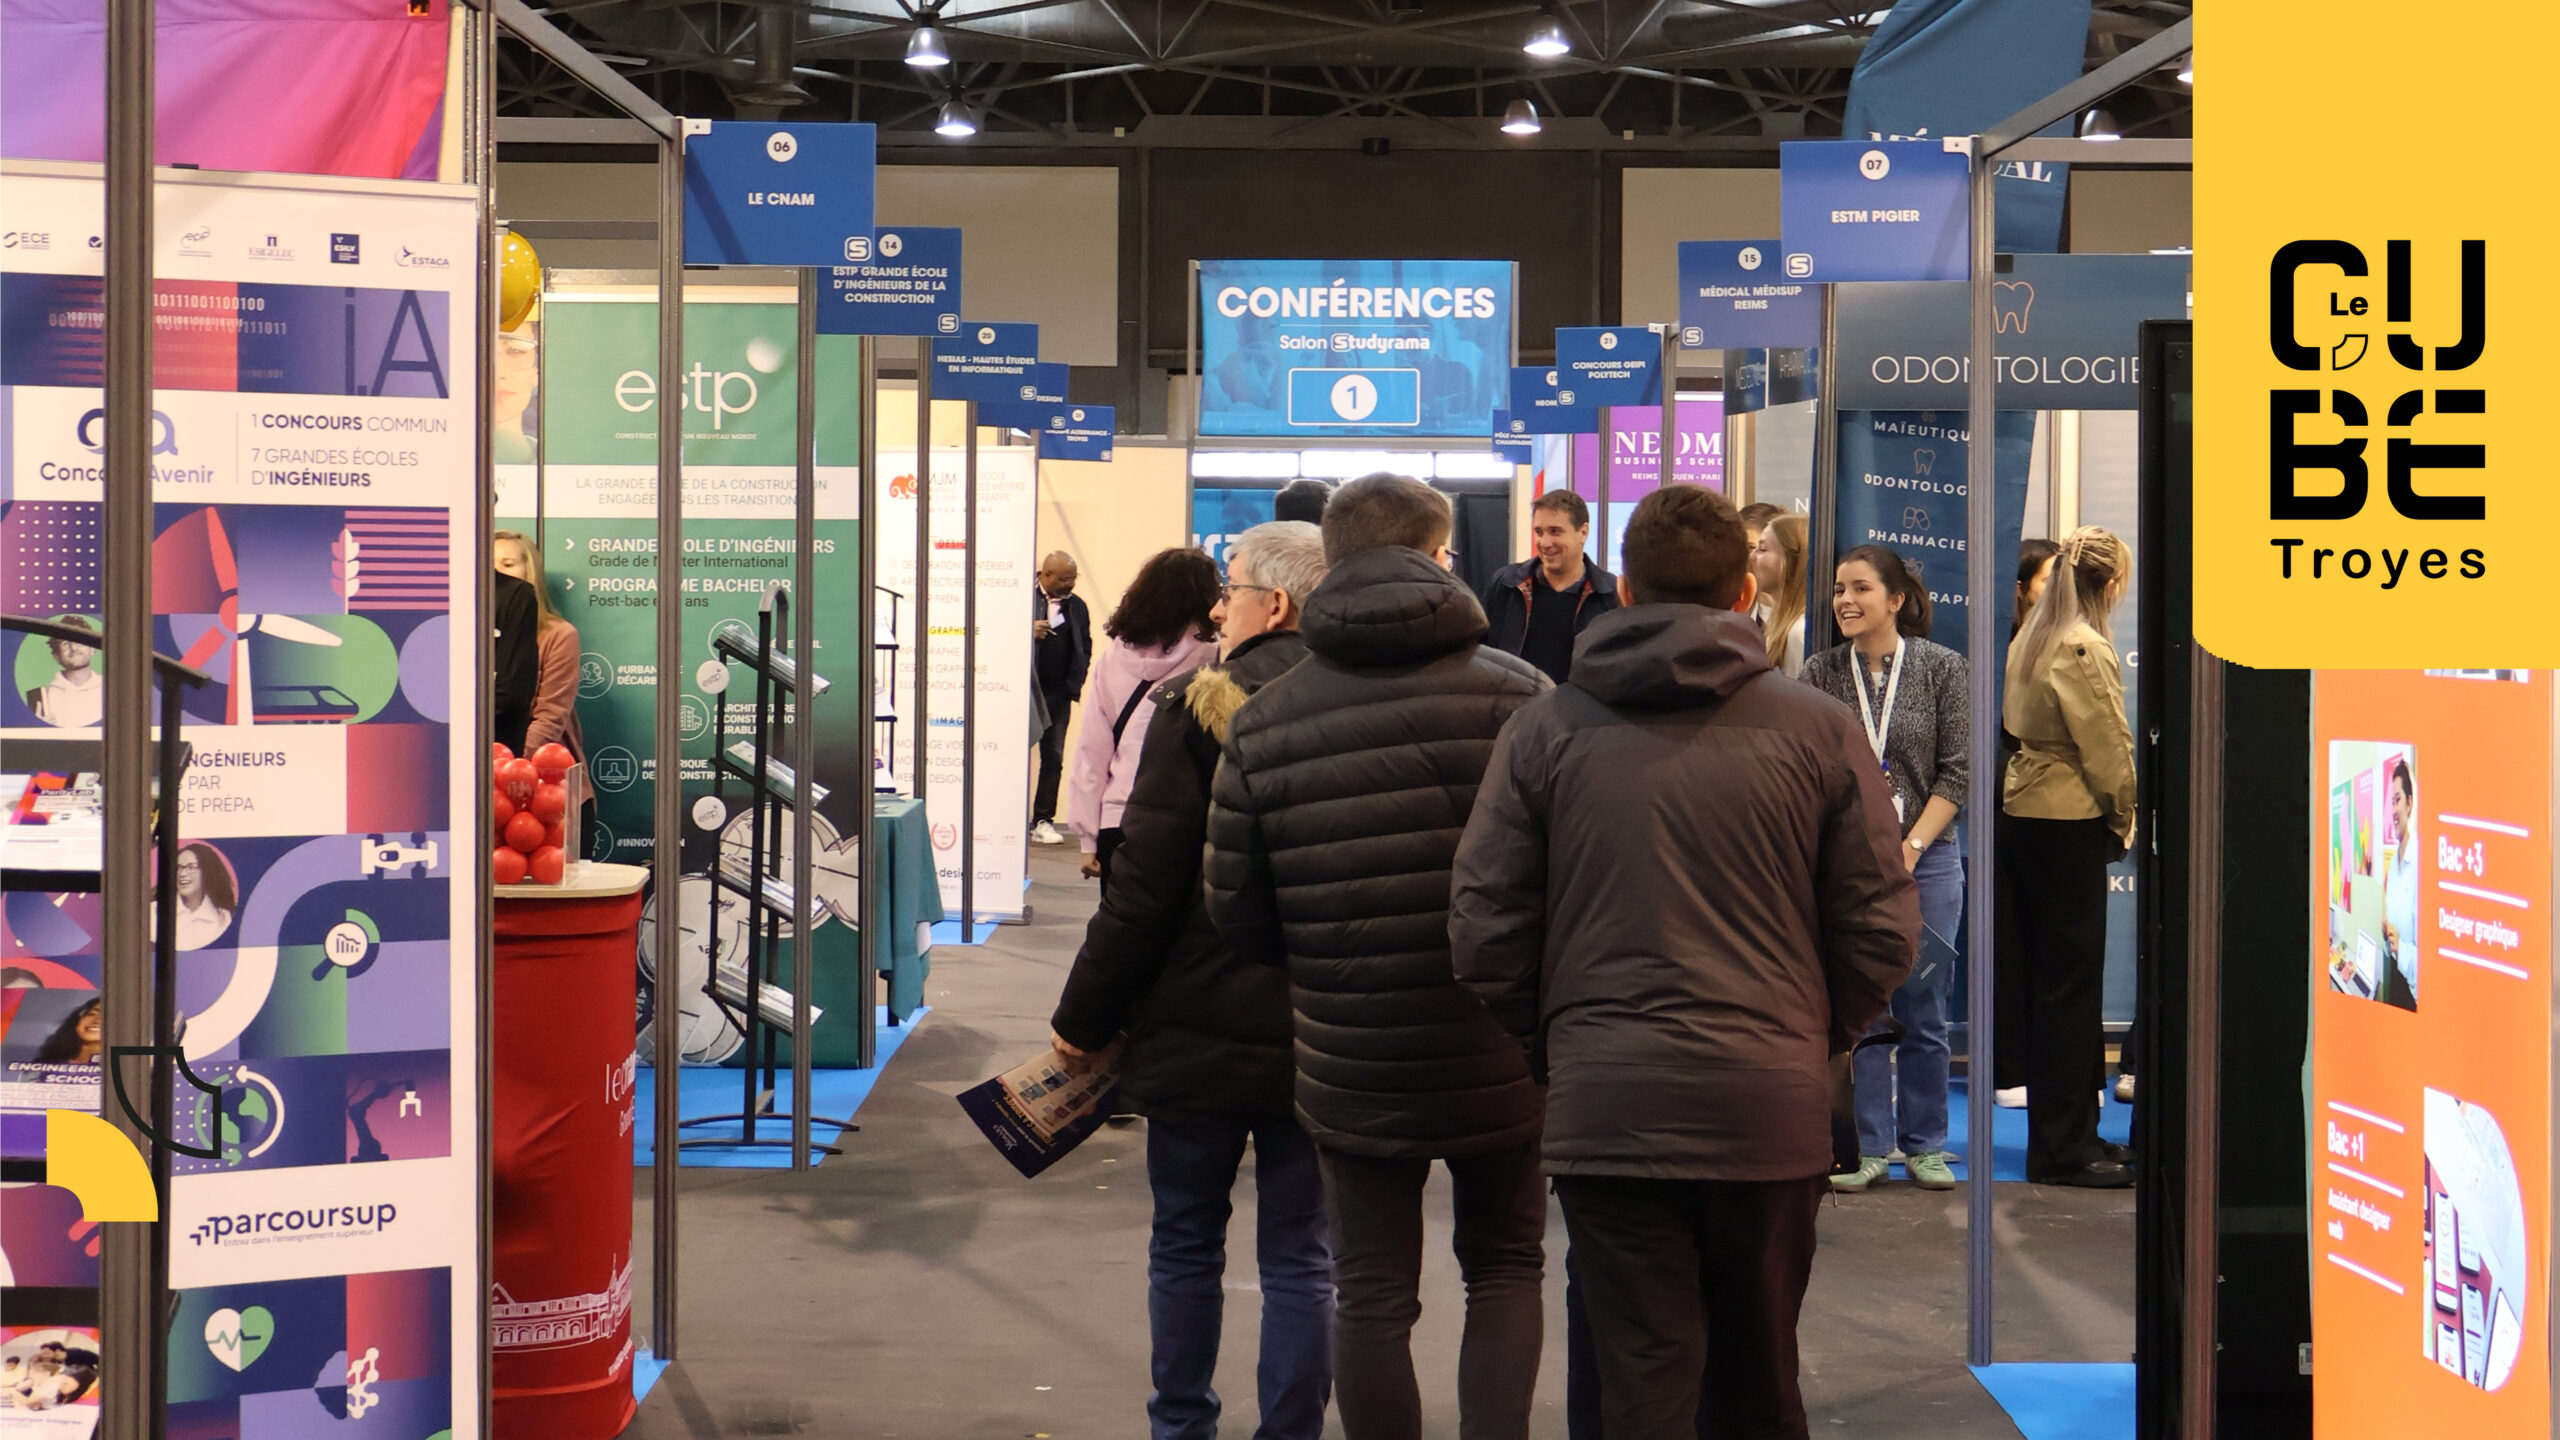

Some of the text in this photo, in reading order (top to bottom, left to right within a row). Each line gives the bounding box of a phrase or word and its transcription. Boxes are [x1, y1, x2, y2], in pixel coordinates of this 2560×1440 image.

[773, 141, 791, 152] 06
[1866, 159, 1882, 170] 07
[748, 192, 815, 206] LE CNAM
[1831, 209, 1920, 223] ESTM PIGIER
[21, 232, 50, 244] ECE
[884, 241, 897, 250] 14
[411, 256, 450, 267] ESTACA
[1743, 253, 1757, 263] 15
[833, 265, 948, 277] ESTP GRANDE ÉCOLE
[833, 277, 946, 291] D'INGÉNIEURS DE LA
[1700, 284, 1802, 298] MÉDICAL MÉDISUP
[845, 292, 935, 304] CONSTRUCTION
[1217, 277, 1496, 319] CONFÉRENCES
[1734, 300, 1768, 310] REIMS
[1279, 333, 1431, 354] Salon Studyrama
[973, 356, 1004, 365] HAUTES
[1572, 360, 1622, 370] CONCOURS
[948, 365, 1024, 375] EN INFORMATIQUE
[1588, 371, 1631, 379] POLYTECH
[1346, 385, 1358, 410] 1
[262, 413, 363, 431] CONCOURS
[366, 416, 447, 433] COMMUN
[251, 447, 418, 467] 7 GRANDES ÉCOLES
[251, 468, 372, 488] D'INGÉNIEURS
[1631, 472, 1659, 480] REIMS
[576, 478, 590, 489] LA
[595, 478, 645, 490] GRANDE
[692, 479, 708, 490] DE
[711, 479, 727, 490] LA
[697, 495, 719, 506] LES
[588, 538, 658, 553] GRANDE
[588, 555, 630, 568] Grade
[632, 555, 649, 568] de
[704, 556, 789, 569] International
[588, 594, 710, 608] Post-bac ans
[188, 775, 221, 790] PAR
[201, 797, 255, 815] PRÉPA
[2438, 835, 2484, 878] Bac +3
[2438, 907, 2519, 951] Designer graphique
[2327, 1120, 2365, 1163] Bac +1
[2327, 1187, 2391, 1232] Assistant designer
[206, 1203, 397, 1245] parcoursup
[2327, 1220, 2344, 1241] web
